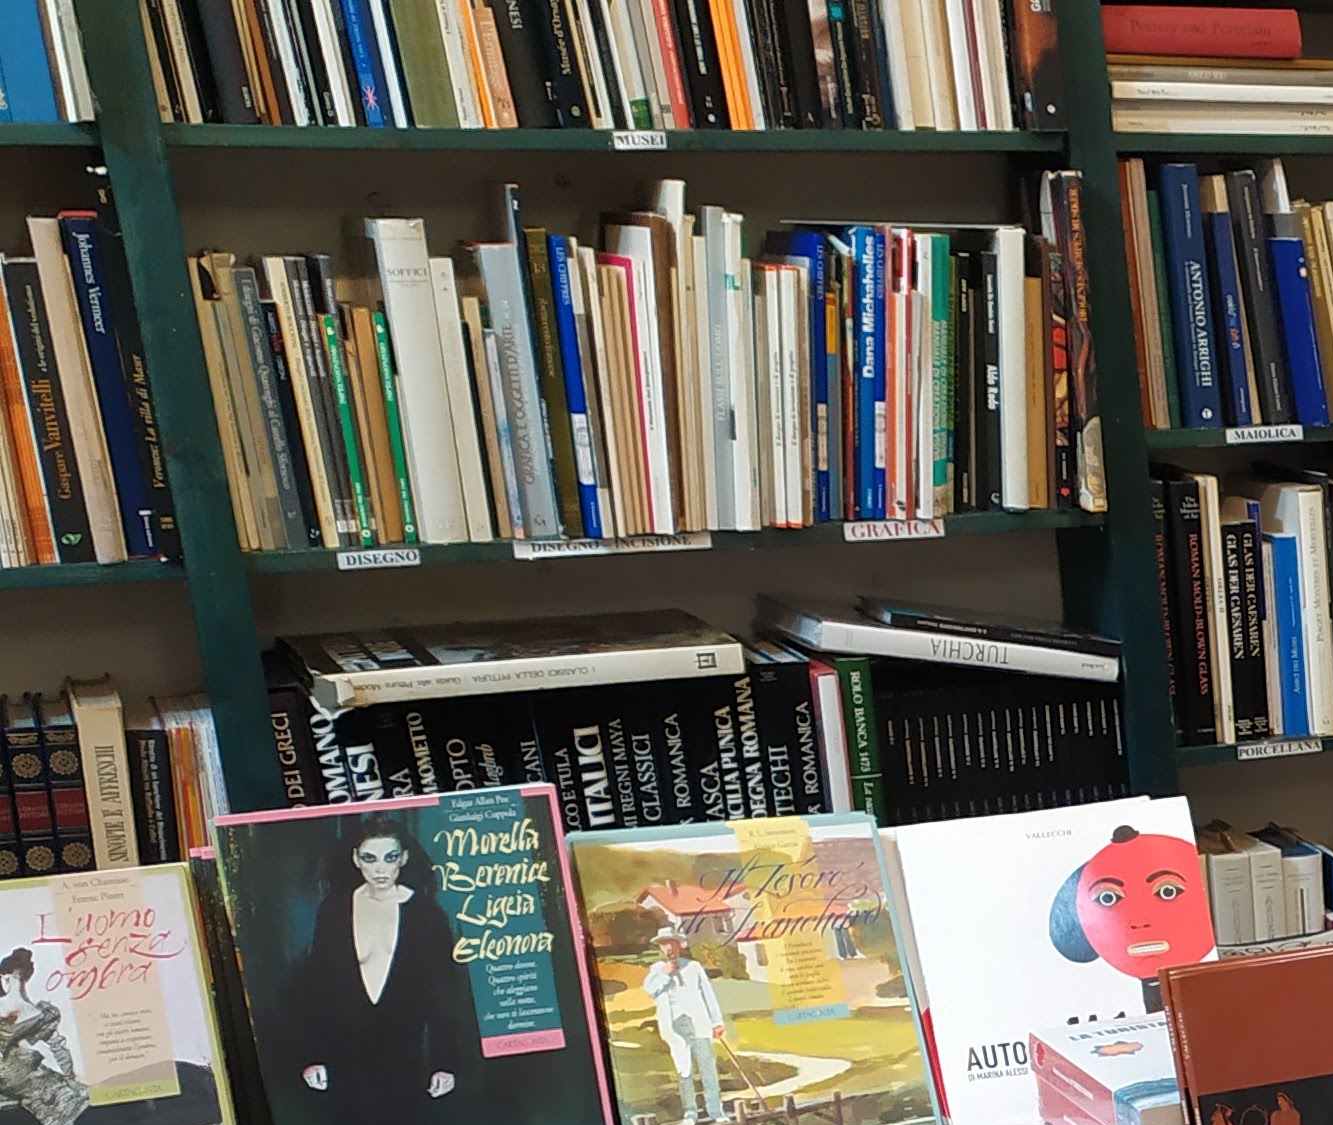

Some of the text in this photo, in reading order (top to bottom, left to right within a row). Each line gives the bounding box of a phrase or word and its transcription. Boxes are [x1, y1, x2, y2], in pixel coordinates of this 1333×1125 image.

[615, 133, 667, 149] MUSEI
[73, 231, 106, 334] Johannes Vermeer
[386, 267, 428, 278] SOFFICI
[862, 234, 875, 378] Dana Michahelles
[1189, 260, 1213, 388] ANTONIO ARRIGHI
[32, 377, 62, 452] Vanvitelli
[1233, 427, 1297, 442] MAIOLICA
[530, 535, 693, 553] DISEGNO INCISIONE
[849, 520, 943, 539] GRAFICA
[345, 550, 418, 568] DISEGNO
[1226, 533, 1241, 595] GLAS DER
[1242, 532, 1257, 592] GLAS DER
[1188, 532, 1209, 696] ROMAN MOLD-BLOWN GLASS
[929, 637, 1010, 665] TURCHIA
[734, 676, 760, 758] ROMANA
[850, 669, 869, 750] ROLO BANCA
[271, 712, 298, 766] GRECI
[713, 705, 738, 764] PUNICA
[794, 700, 820, 795] ROMANICA
[1238, 741, 1322, 759] PORCELLANA
[572, 724, 617, 828] ITALICI
[631, 733, 662, 823] CLASSICI
[664, 712, 692, 808] ROMANICA
[94, 744, 129, 864] SINOPIE AFFRESCHI
[474, 796, 495, 806] Allan
[433, 817, 540, 857] Morella
[431, 857, 551, 892] Berenice
[456, 889, 536, 928] Ligeia
[452, 929, 555, 964] Eleonora
[45, 957, 152, 1000] ombra
[966, 1041, 1028, 1072] AUTO
[976, 1067, 1029, 1081] MARINA ALESSI
